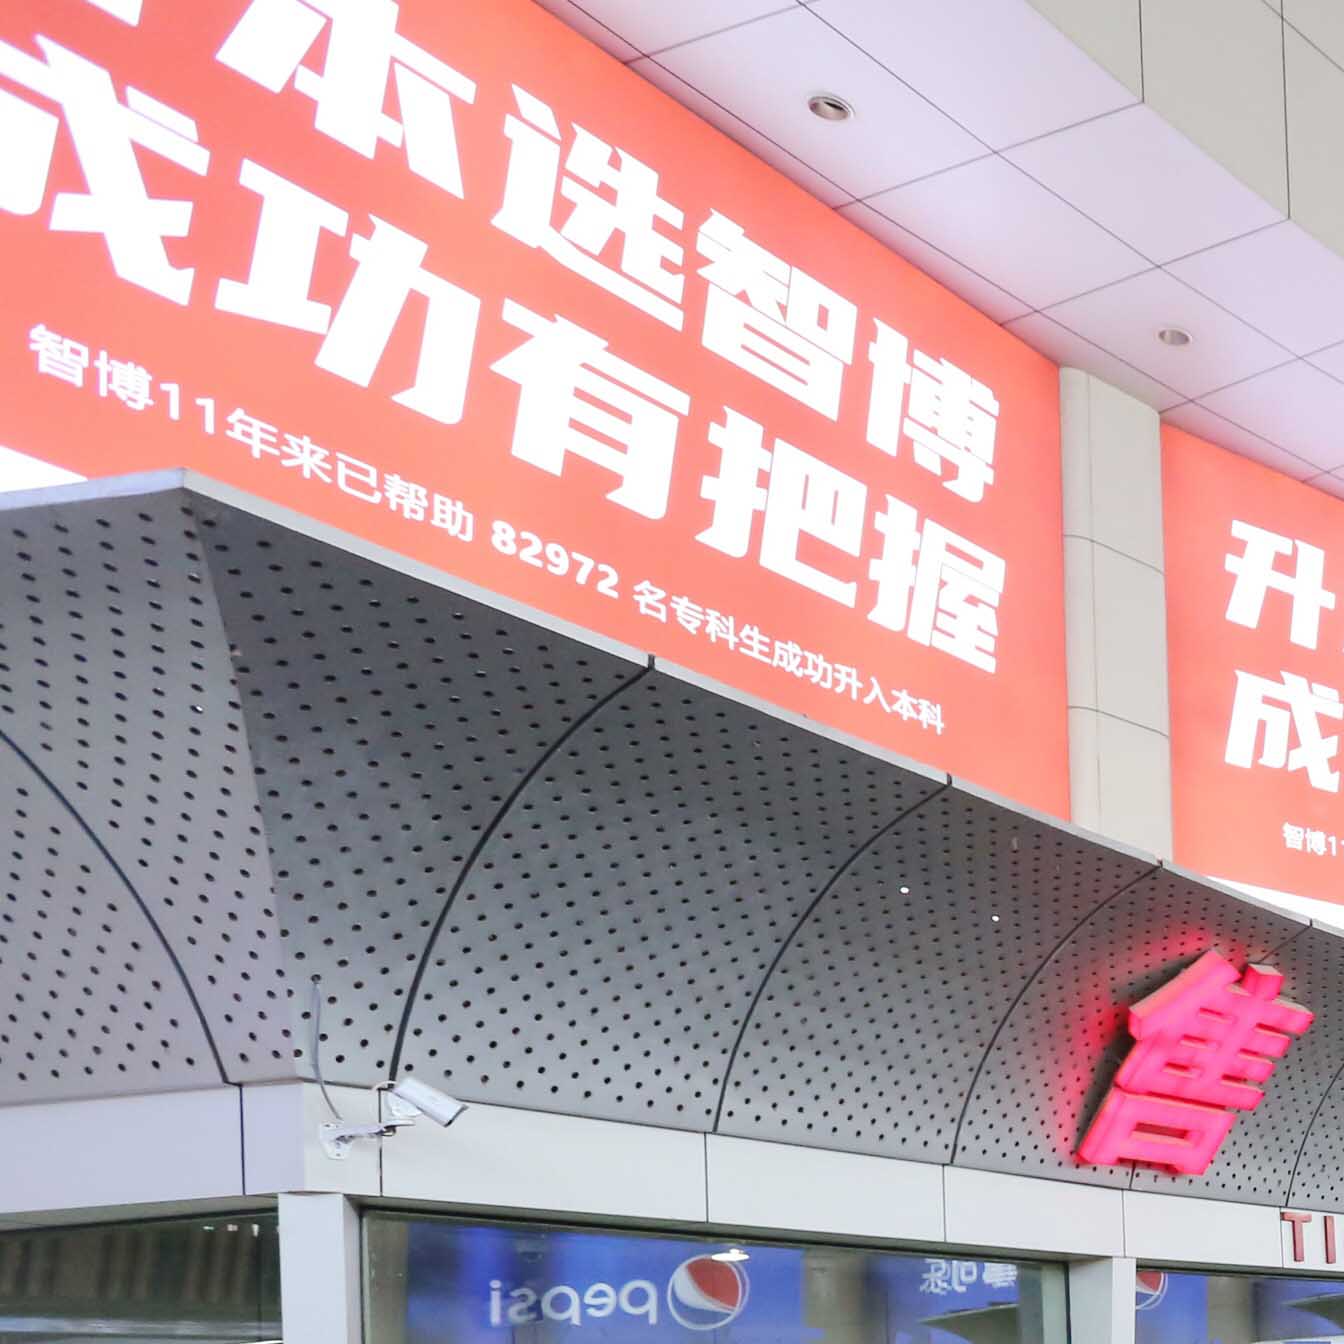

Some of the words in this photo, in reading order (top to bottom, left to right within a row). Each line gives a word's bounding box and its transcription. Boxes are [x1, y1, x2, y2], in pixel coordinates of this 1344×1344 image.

[0, 34, 1006, 674] 成功有把握
[64, 0, 1000, 504] 本选智博
[28, 322, 476, 542] 智博11年来已帮助
[490, 520, 619, 599] 82972
[632, 580, 945, 736] 名专科生成功升入本科
